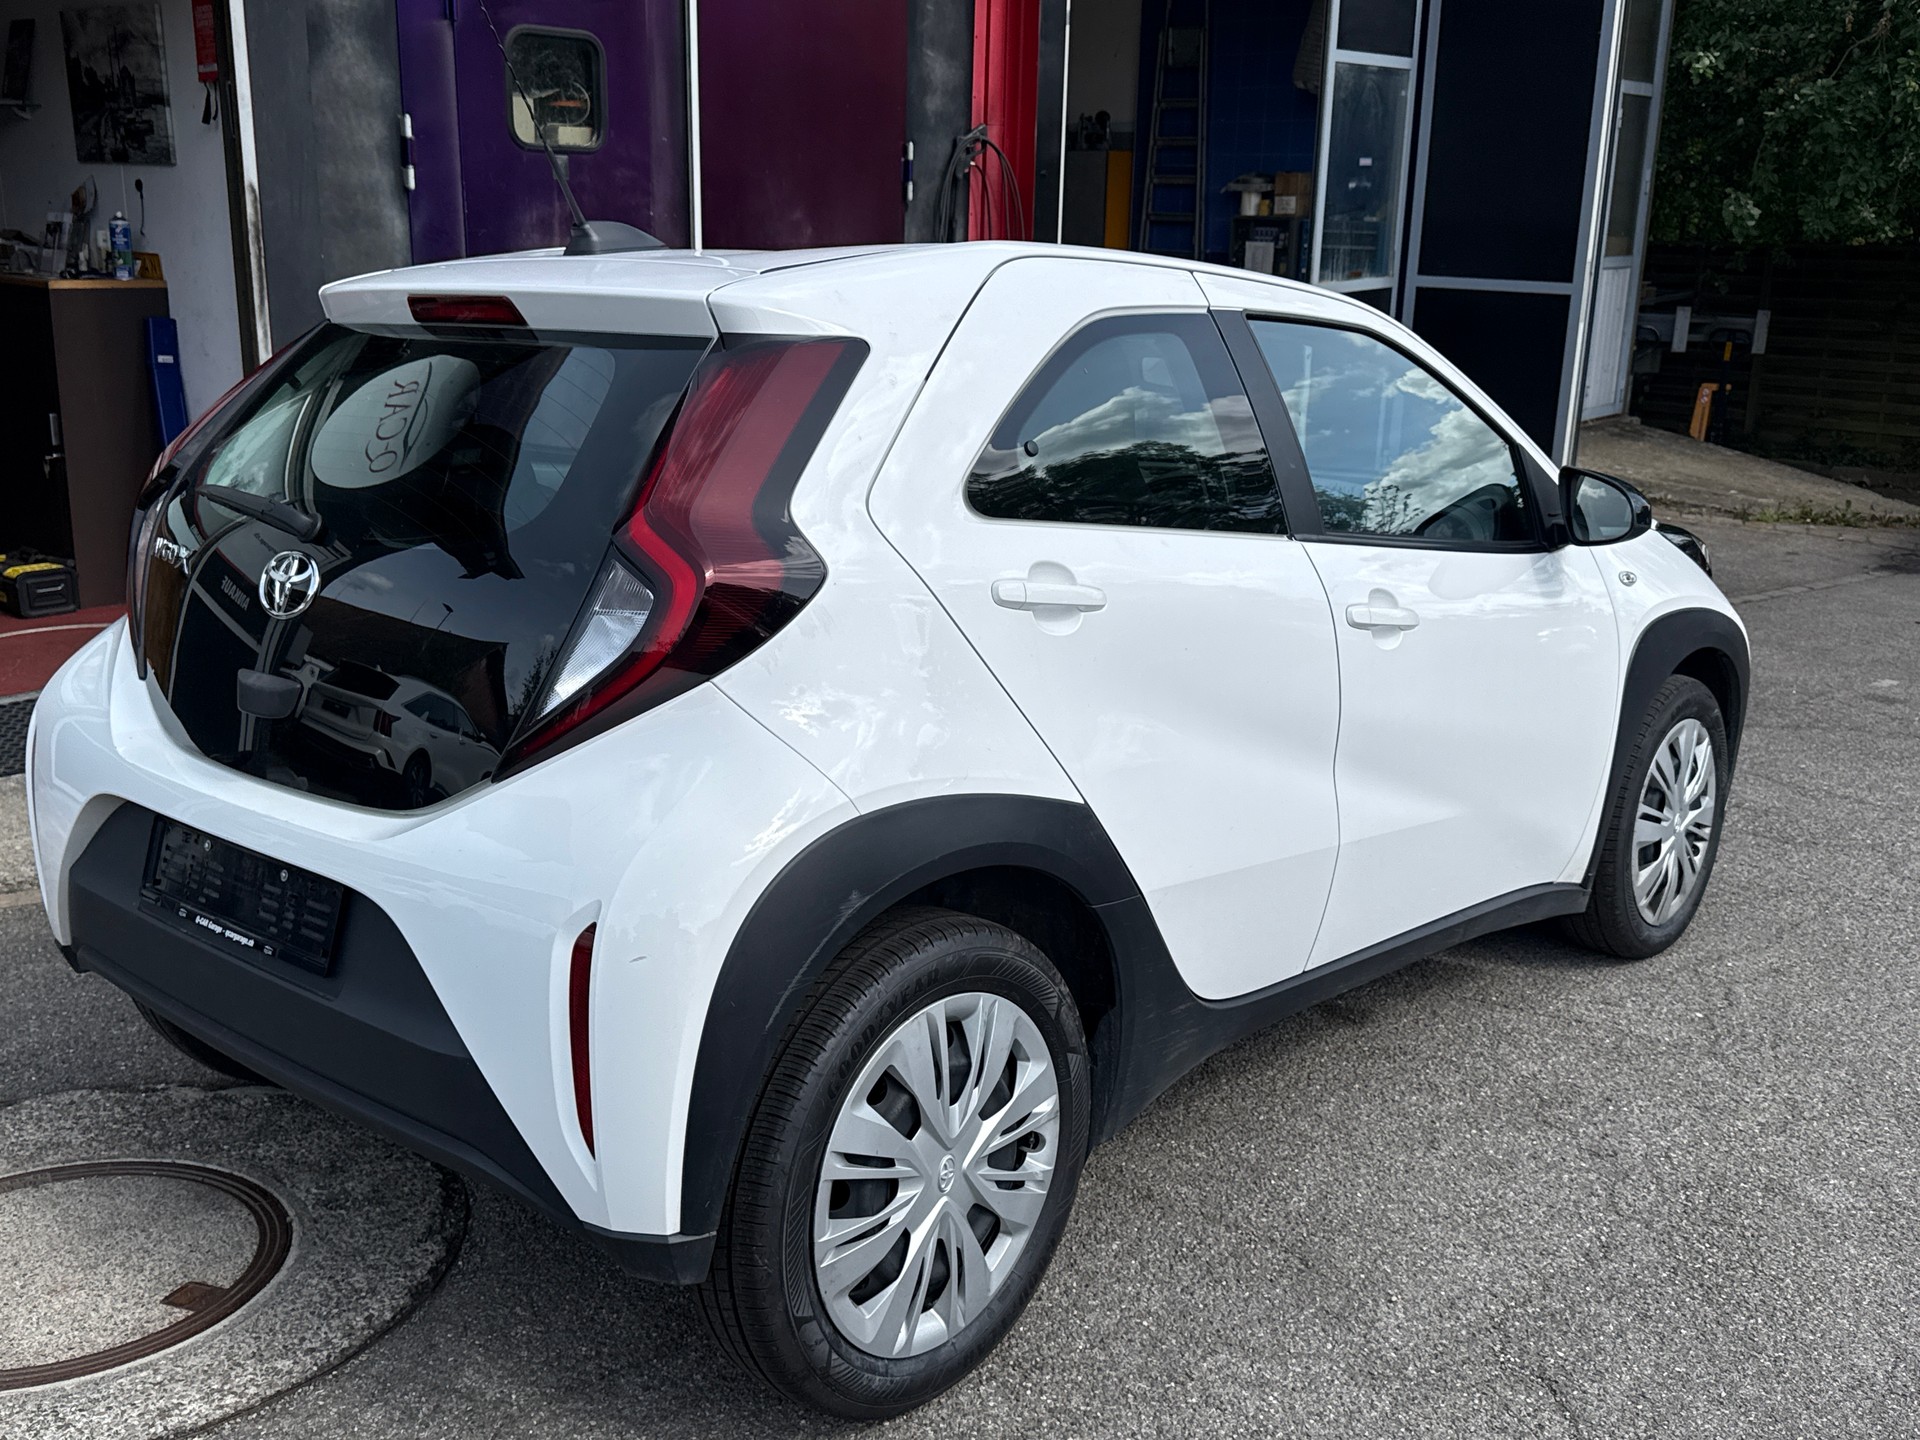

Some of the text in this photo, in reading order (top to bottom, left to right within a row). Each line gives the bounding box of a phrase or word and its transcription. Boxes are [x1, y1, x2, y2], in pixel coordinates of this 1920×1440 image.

[208, 921, 223, 934] Garage
[224, 929, 254, 947] qcargarage.ch
[827, 968, 938, 1099] GOODYEAR
